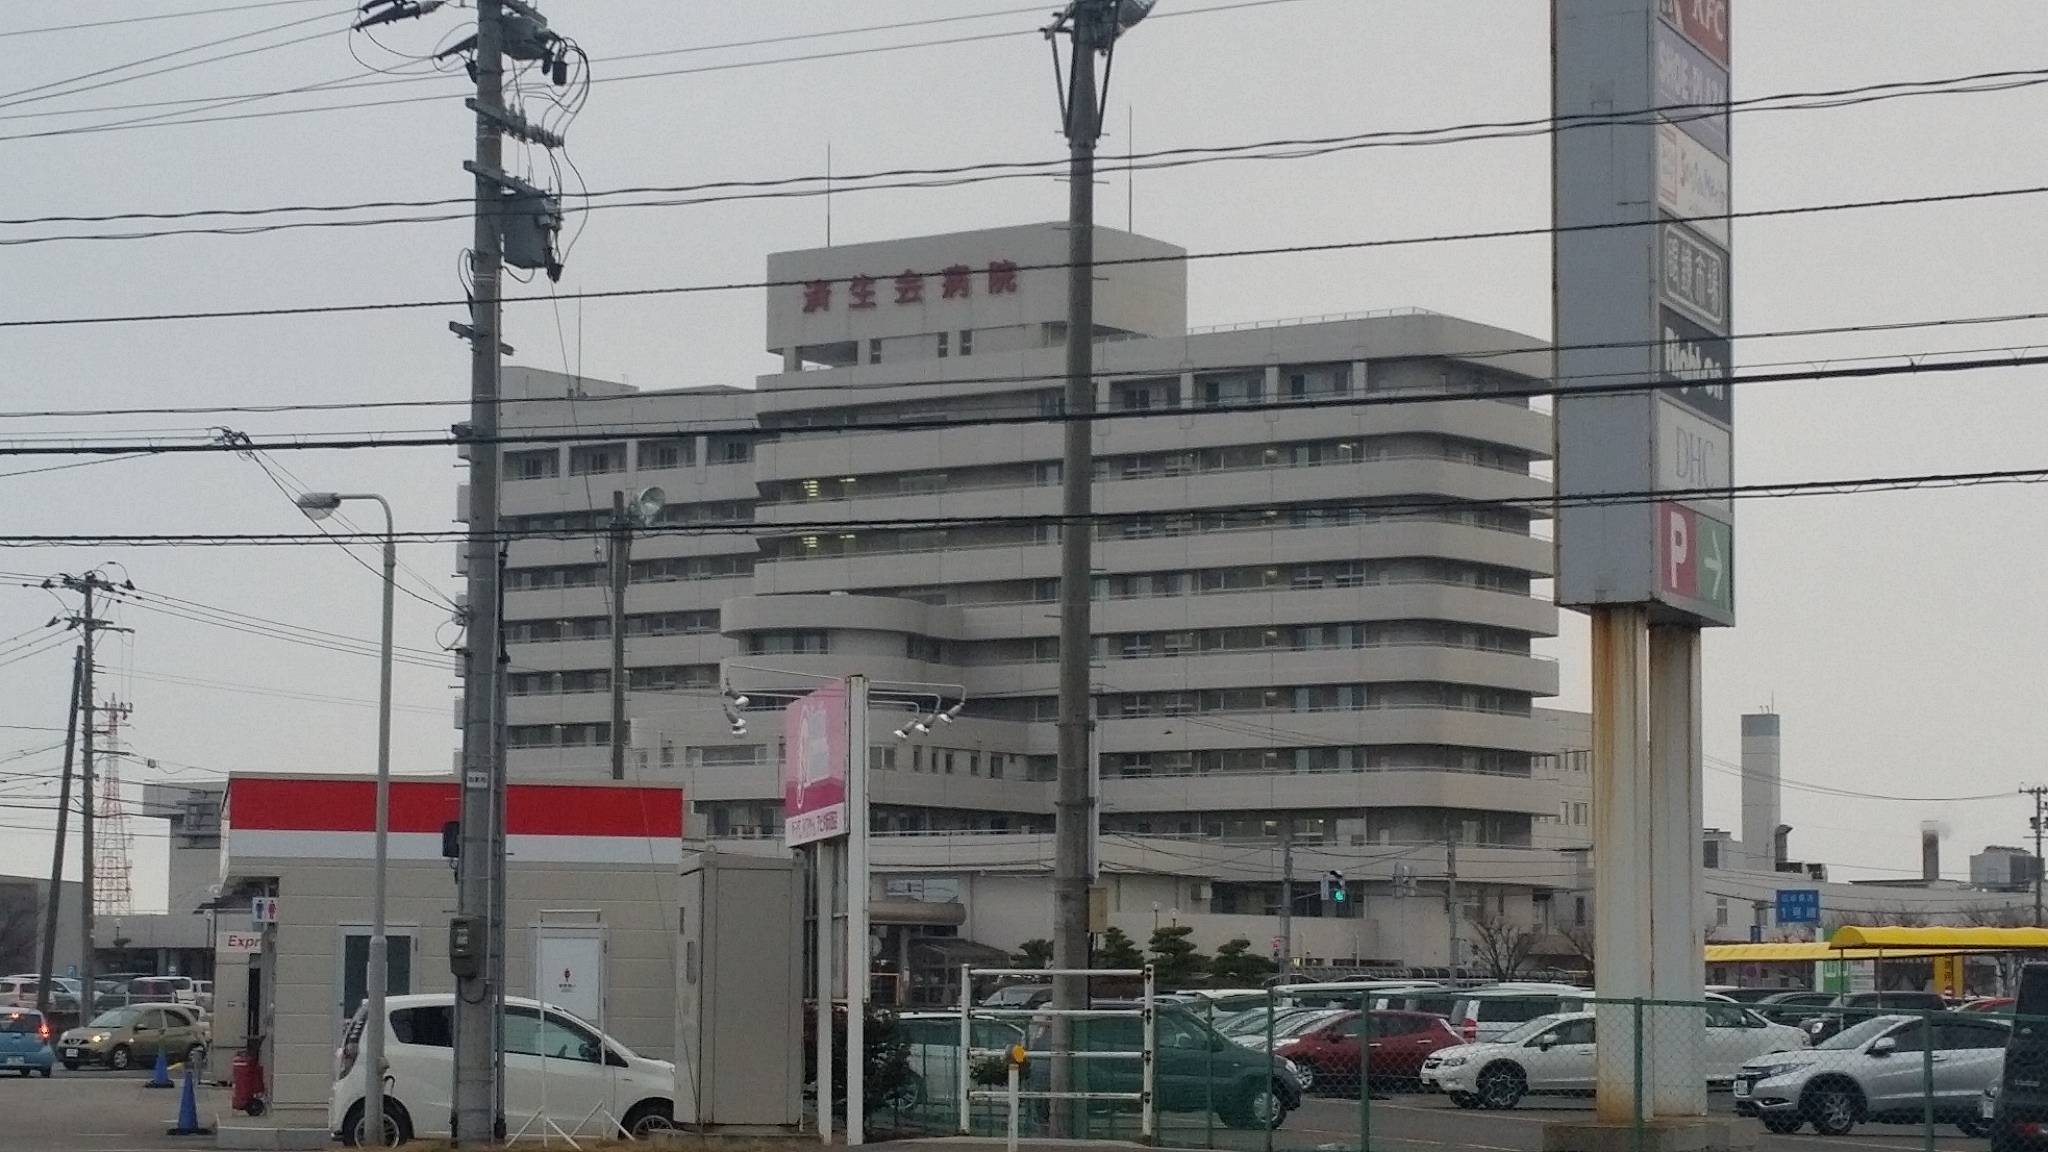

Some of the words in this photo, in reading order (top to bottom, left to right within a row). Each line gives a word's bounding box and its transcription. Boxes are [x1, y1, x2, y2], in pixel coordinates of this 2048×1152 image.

[1692, 0, 1724, 41] KFC
[1676, 426, 1715, 487] DHC
[1670, 511, 1687, 588] P
